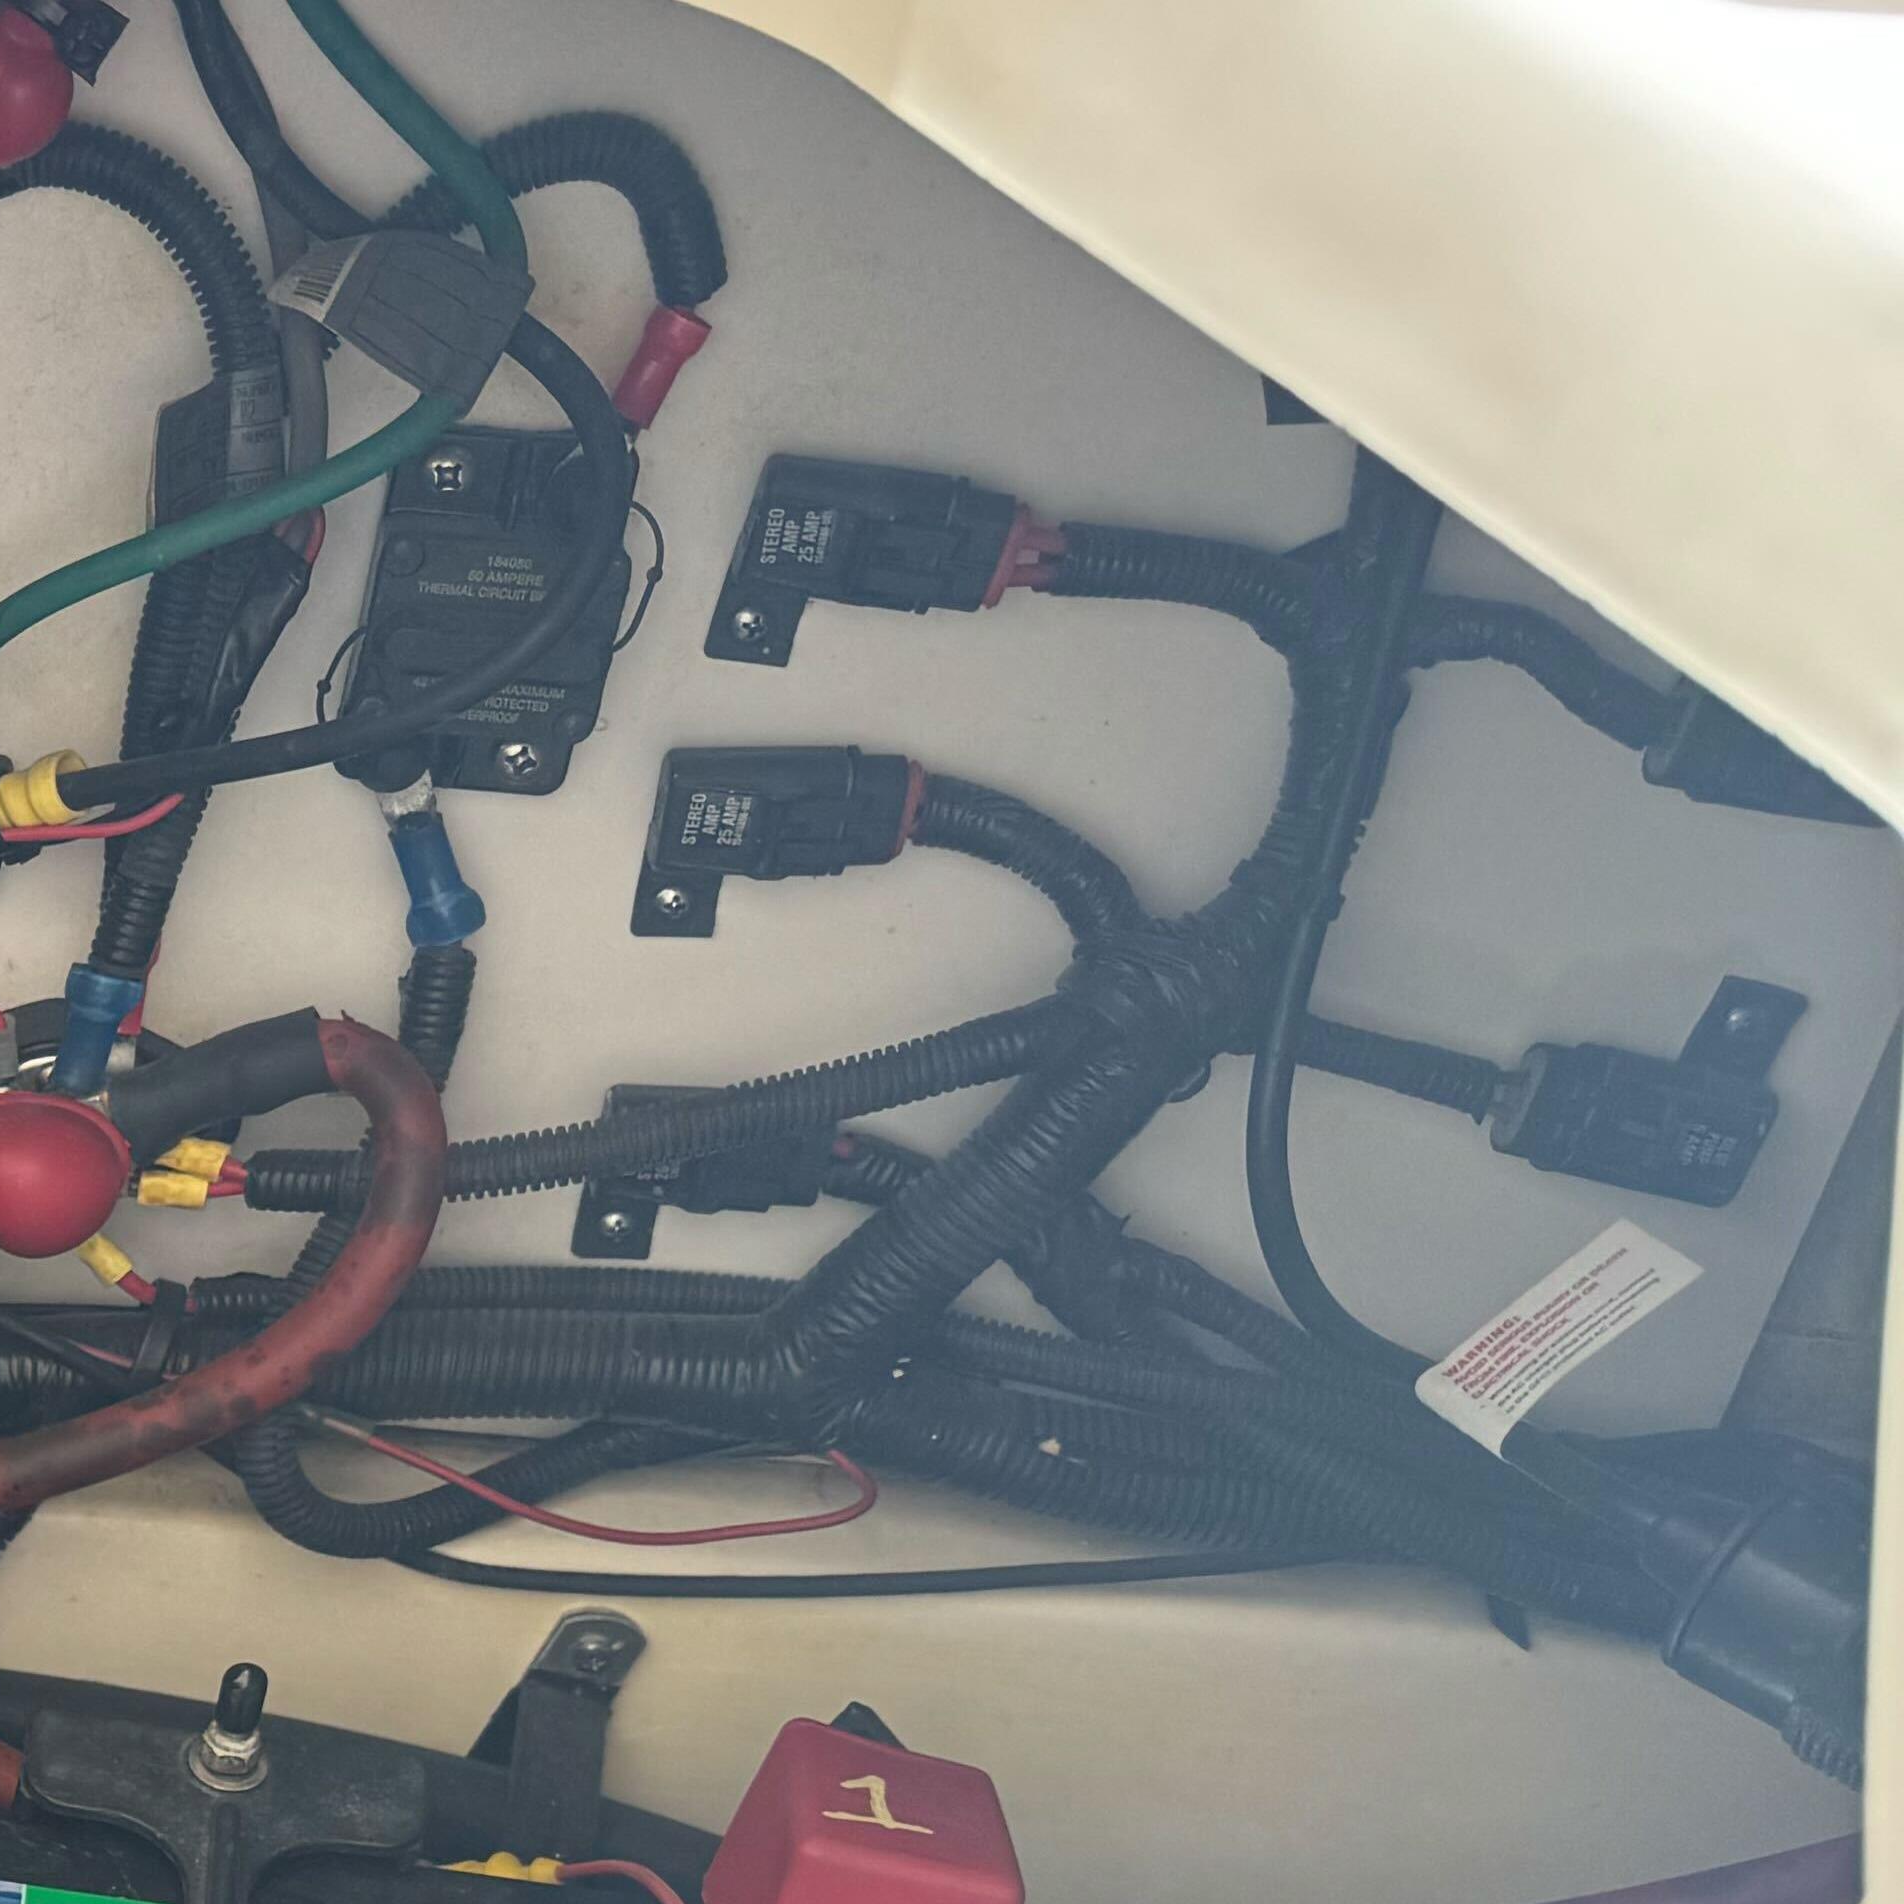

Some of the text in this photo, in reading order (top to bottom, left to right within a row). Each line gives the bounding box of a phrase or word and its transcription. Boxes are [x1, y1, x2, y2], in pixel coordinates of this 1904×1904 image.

[759, 508, 785, 564] STEREO
[781, 520, 801, 553] AMP
[801, 510, 820, 542] AMP
[486, 570, 544, 587] AMPERE
[681, 793, 707, 845] STEREO
[702, 804, 721, 835] AMP
[722, 797, 741, 826] AMP
[821, 1775, 933, 1835] 1
